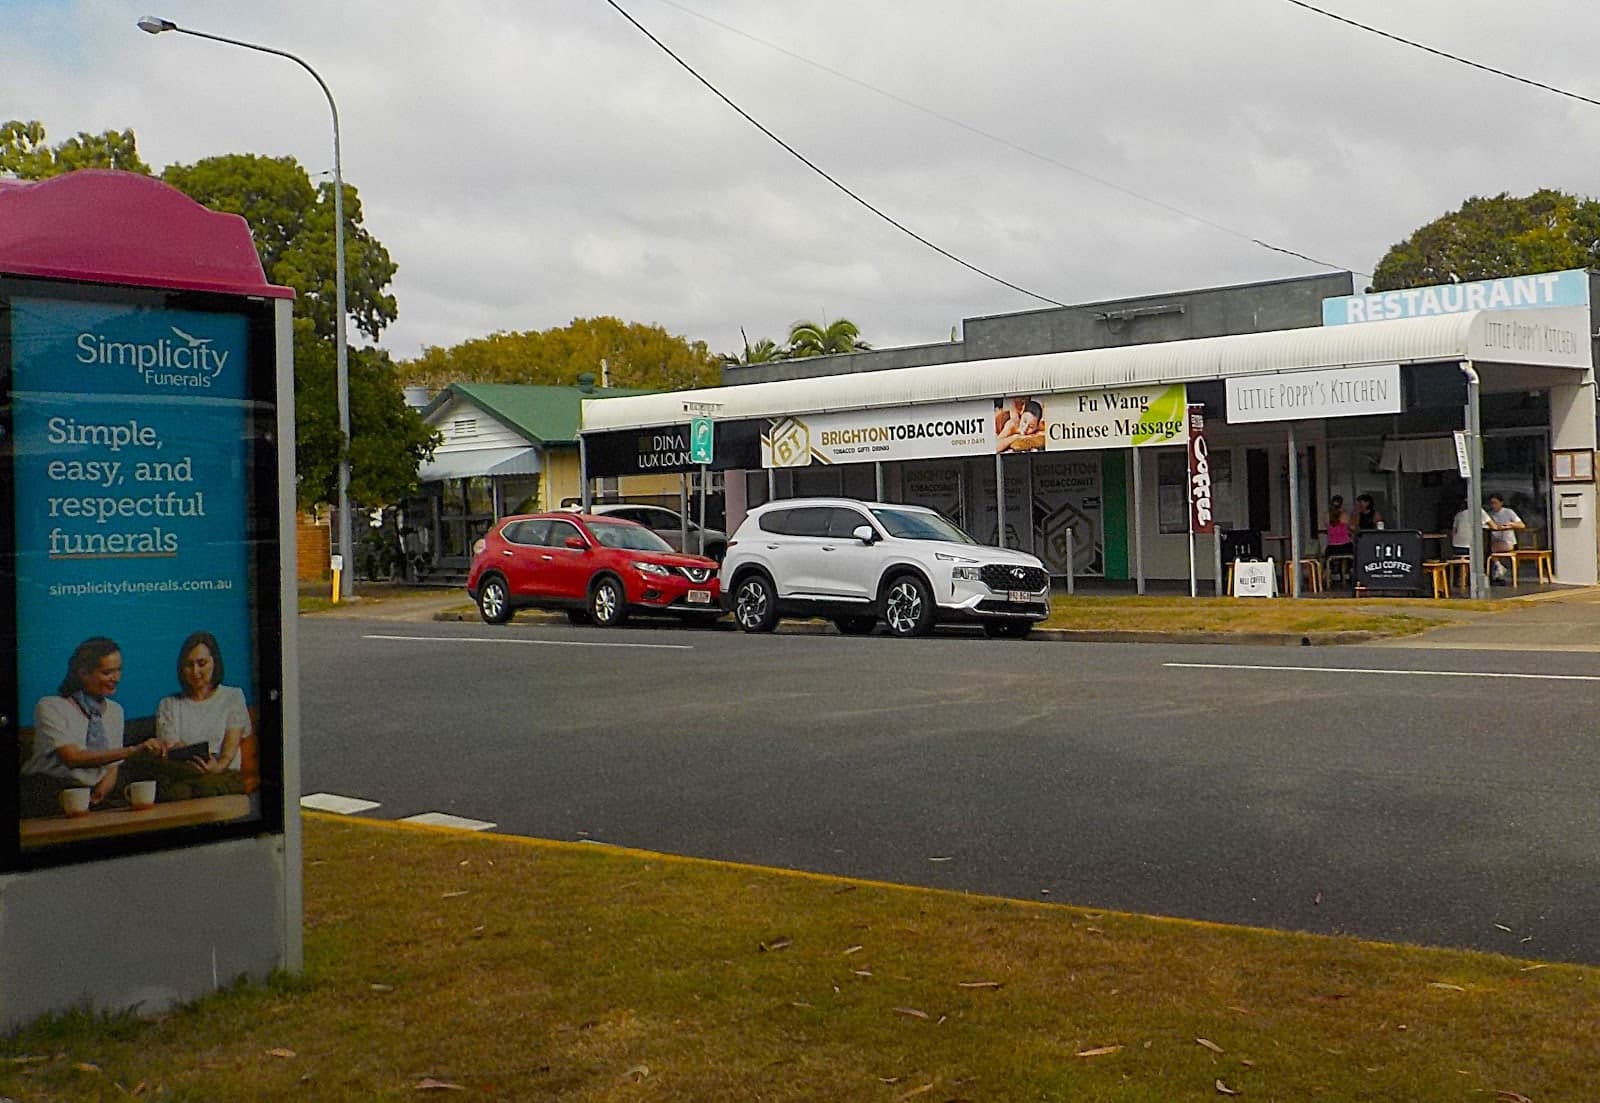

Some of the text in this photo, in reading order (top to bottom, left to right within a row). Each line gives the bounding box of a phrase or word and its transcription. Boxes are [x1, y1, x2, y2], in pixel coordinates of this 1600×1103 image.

[1347, 276, 1558, 323] RESTAURANT
[1485, 321, 1510, 349] LITTLE
[1544, 325, 1576, 354] KITCHEN
[76, 333, 229, 377] Simplicity
[144, 369, 211, 388] Funerals
[1078, 393, 1149, 413] Fu Wang
[1237, 378, 1387, 411] LITTLE POPPY'S KITCHEN
[48, 417, 162, 450] Simple,
[1049, 423, 1109, 440] Chinese
[1114, 418, 1183, 438] Massage
[653, 435, 685, 451] DINA
[48, 457, 192, 487] easy, and
[639, 454, 659, 468] LUX
[48, 492, 205, 523] respectful
[49, 528, 178, 554] funerals
[1364, 561, 1412, 573] NELI COFFEE
[50, 579, 232, 596] simplicityfunerals.com.au
